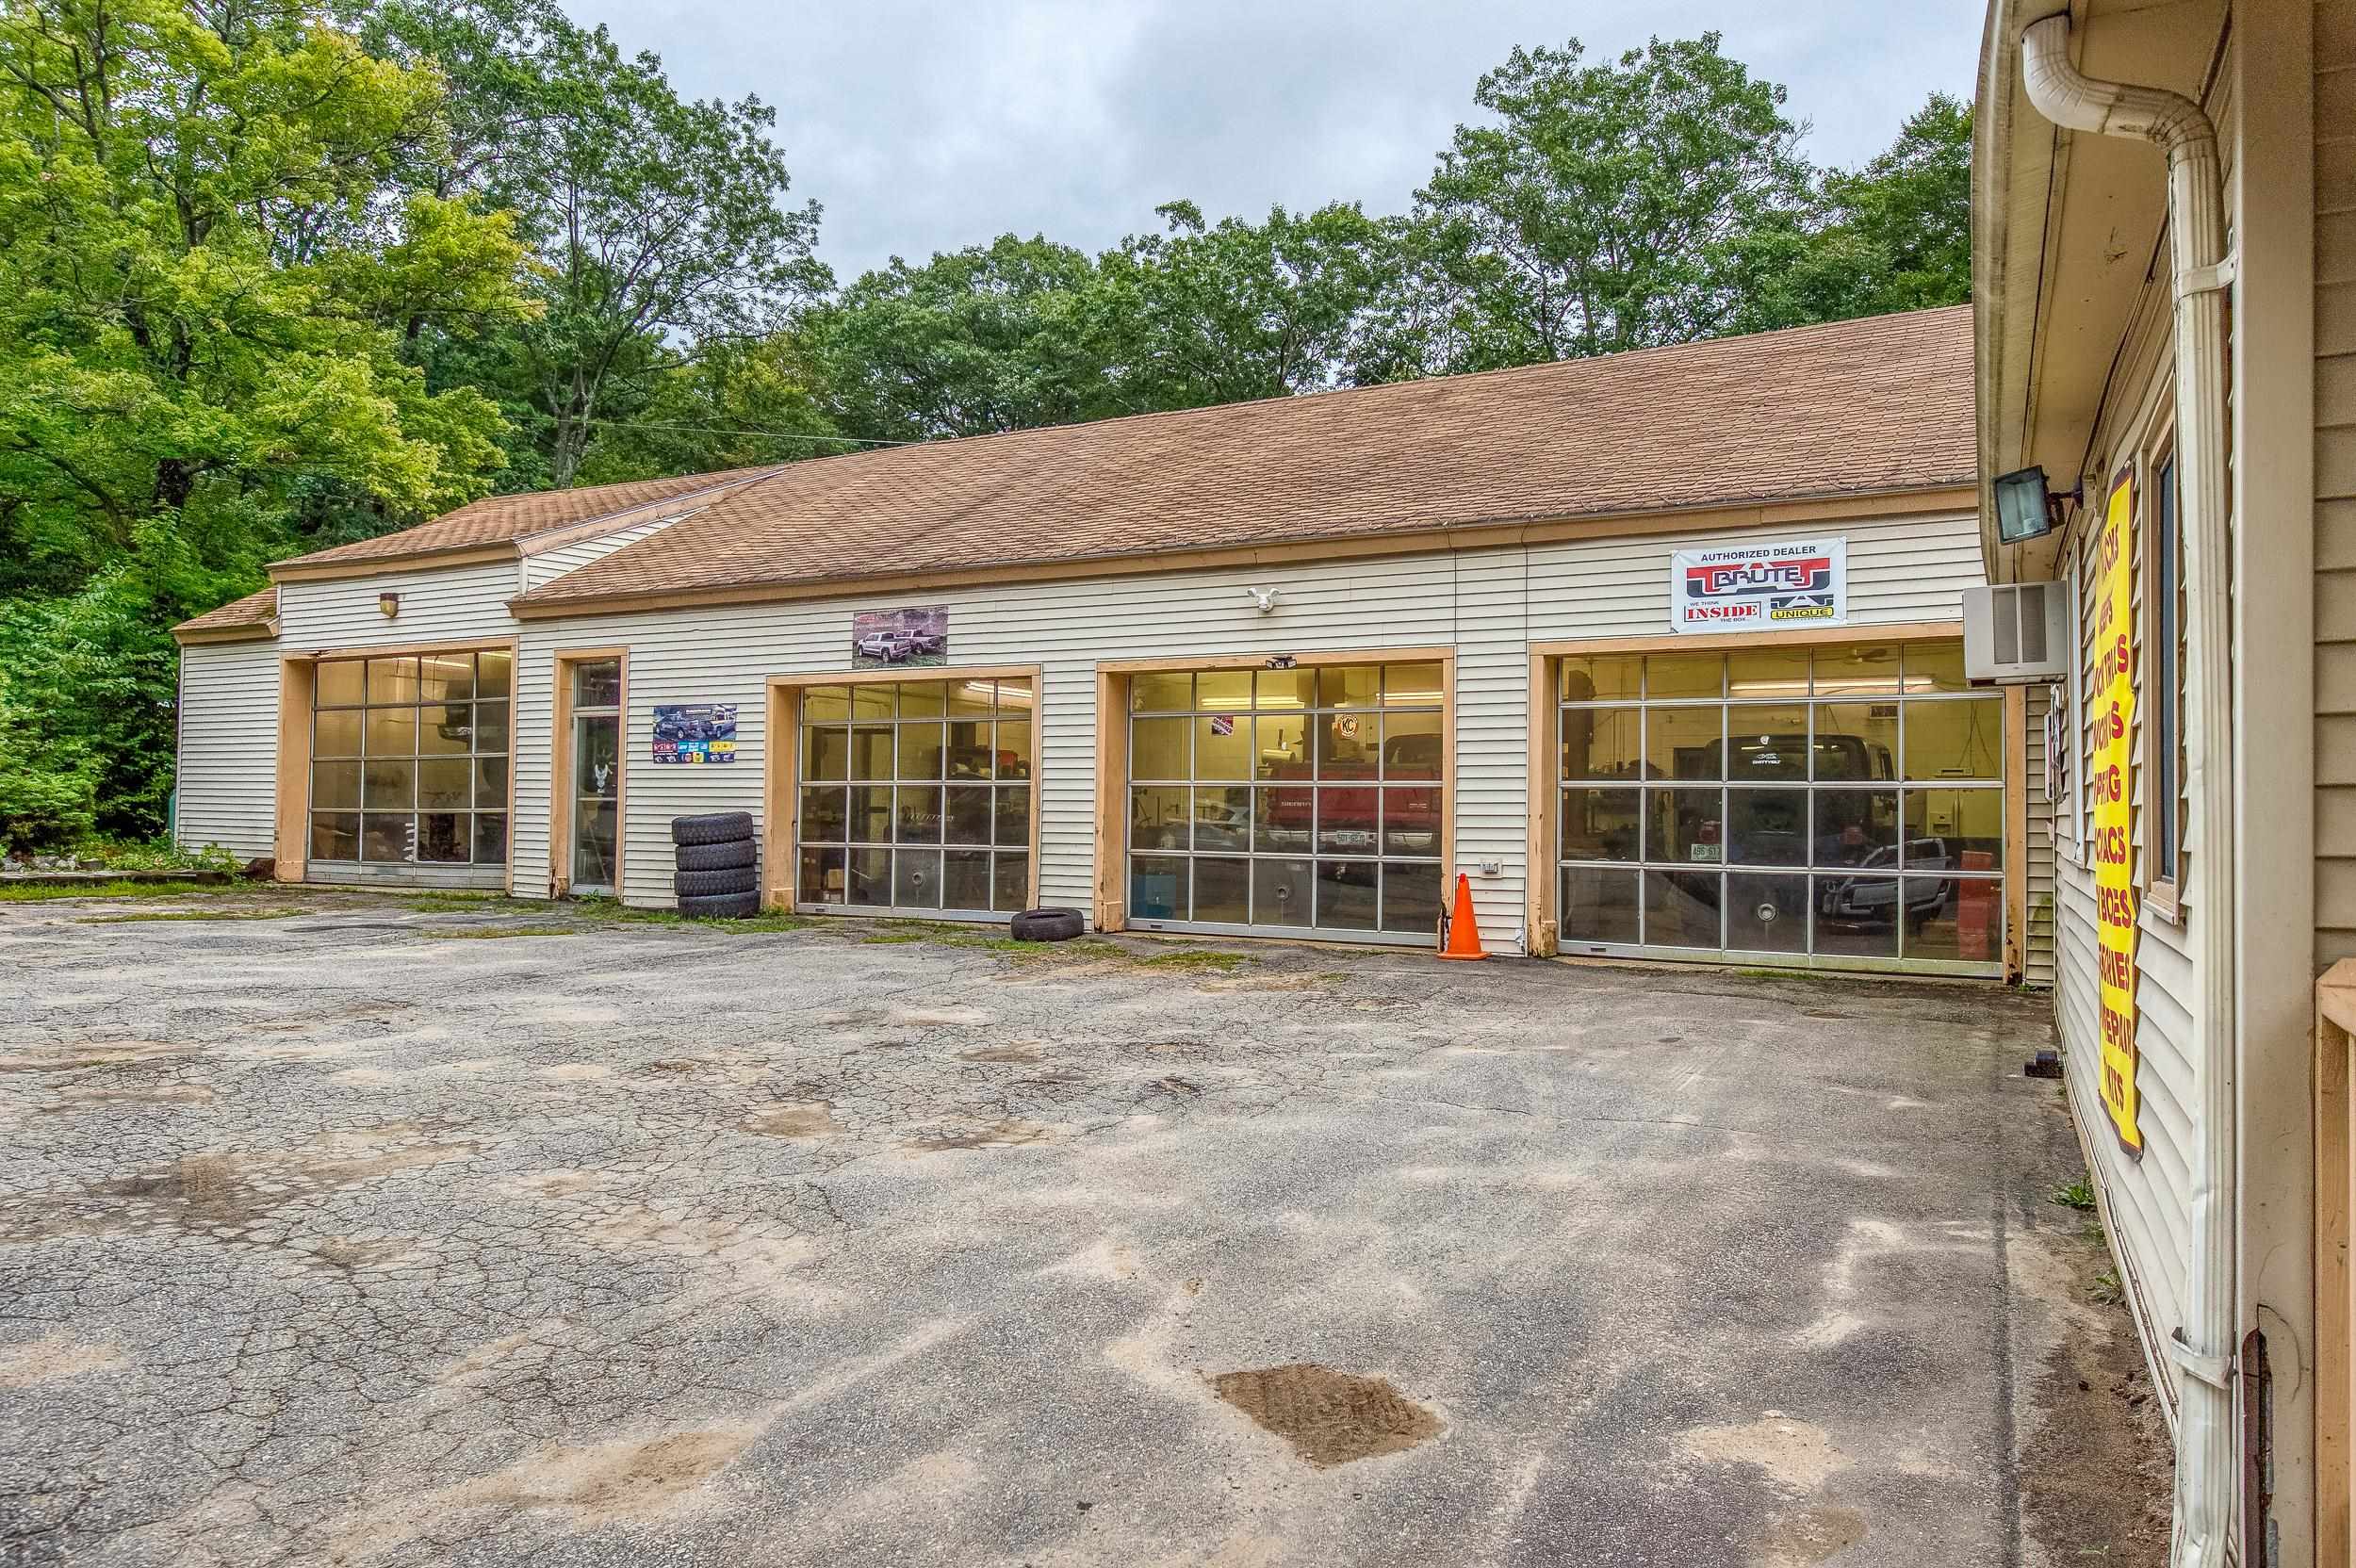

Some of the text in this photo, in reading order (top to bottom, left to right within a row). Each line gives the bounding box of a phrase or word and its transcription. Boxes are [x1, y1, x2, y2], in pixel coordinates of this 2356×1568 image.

[1701, 546, 1817, 563] AUTHORIZED DEALER
[1713, 566, 1803, 588] BRUTE
[1687, 605, 1758, 619] INSIDE
[1775, 609, 1829, 618] UNIQUE
[1342, 717, 1354, 733] KC
